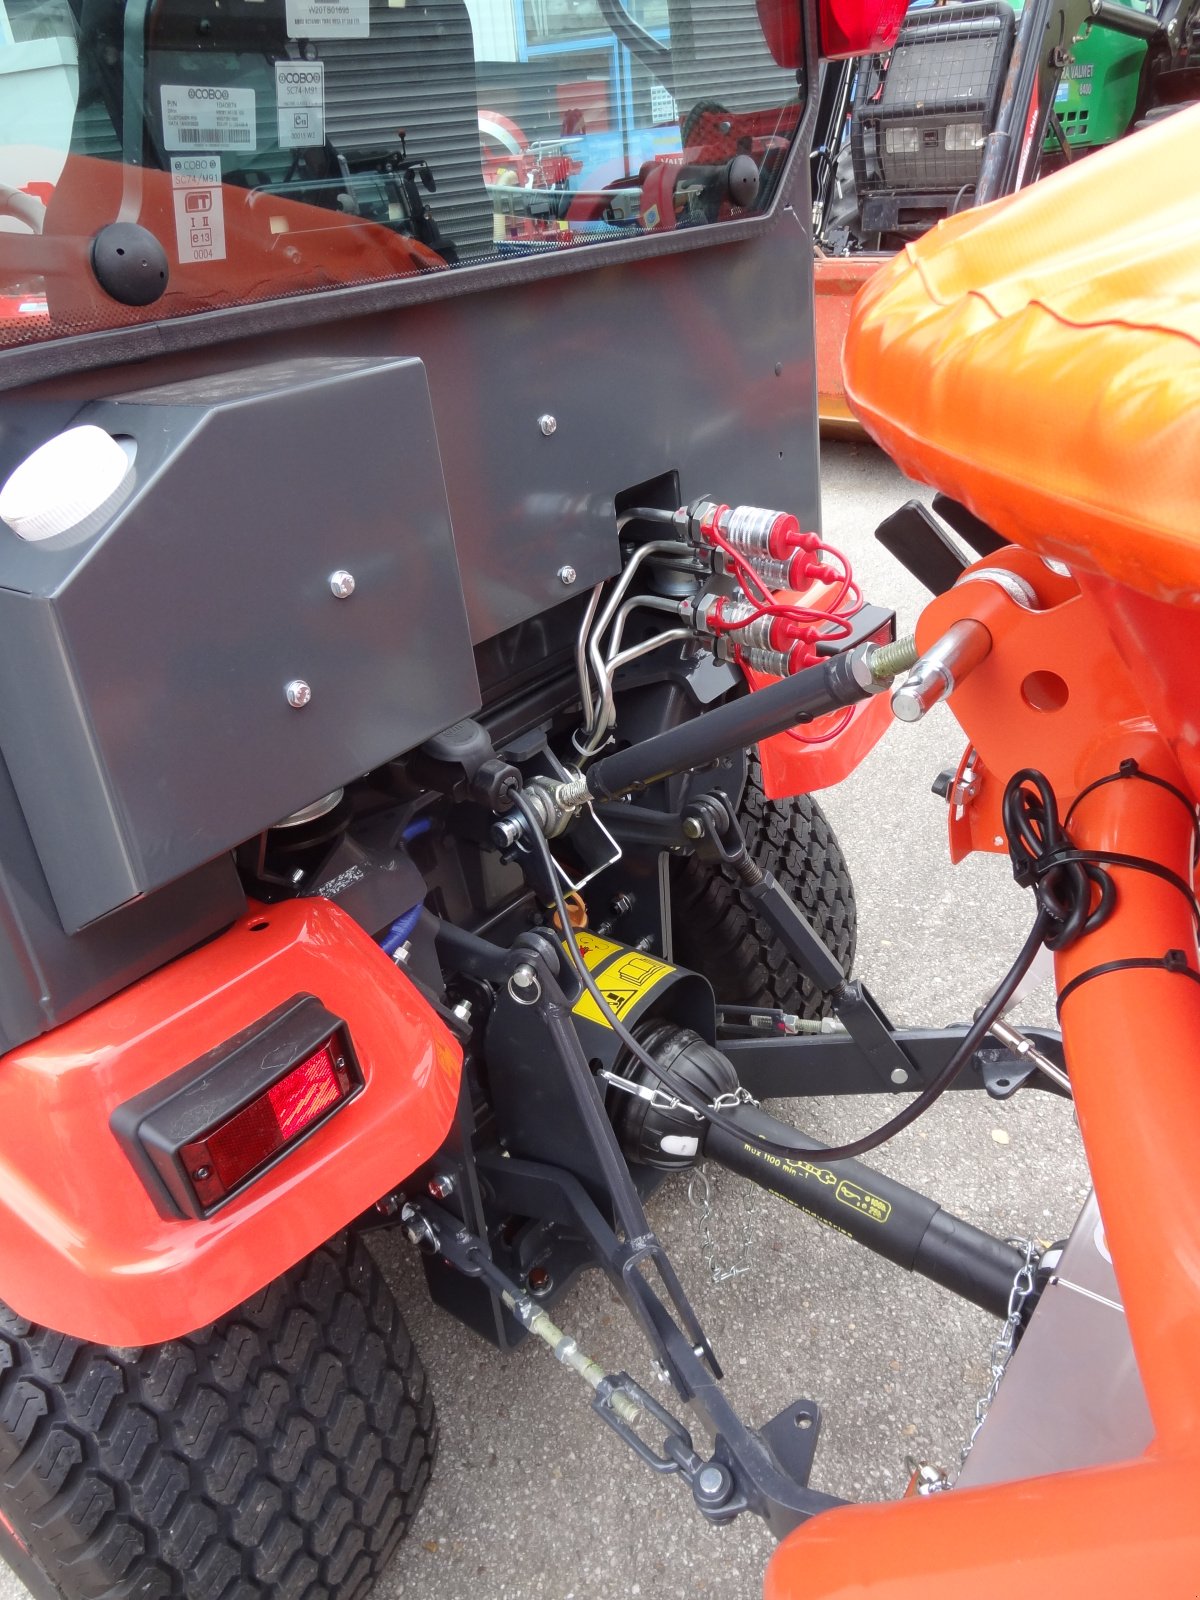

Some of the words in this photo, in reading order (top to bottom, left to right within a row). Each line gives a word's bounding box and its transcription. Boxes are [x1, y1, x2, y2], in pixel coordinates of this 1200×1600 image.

[1071, 64, 1094, 79] VALMET
[183, 160, 207, 170] COBO
[175, 173, 218, 185] SC74/M91
[192, 232, 210, 243] e13
[193, 249, 213, 260] 0004
[764, 1153, 781, 1167] 1100
[782, 1164, 797, 1176] min
